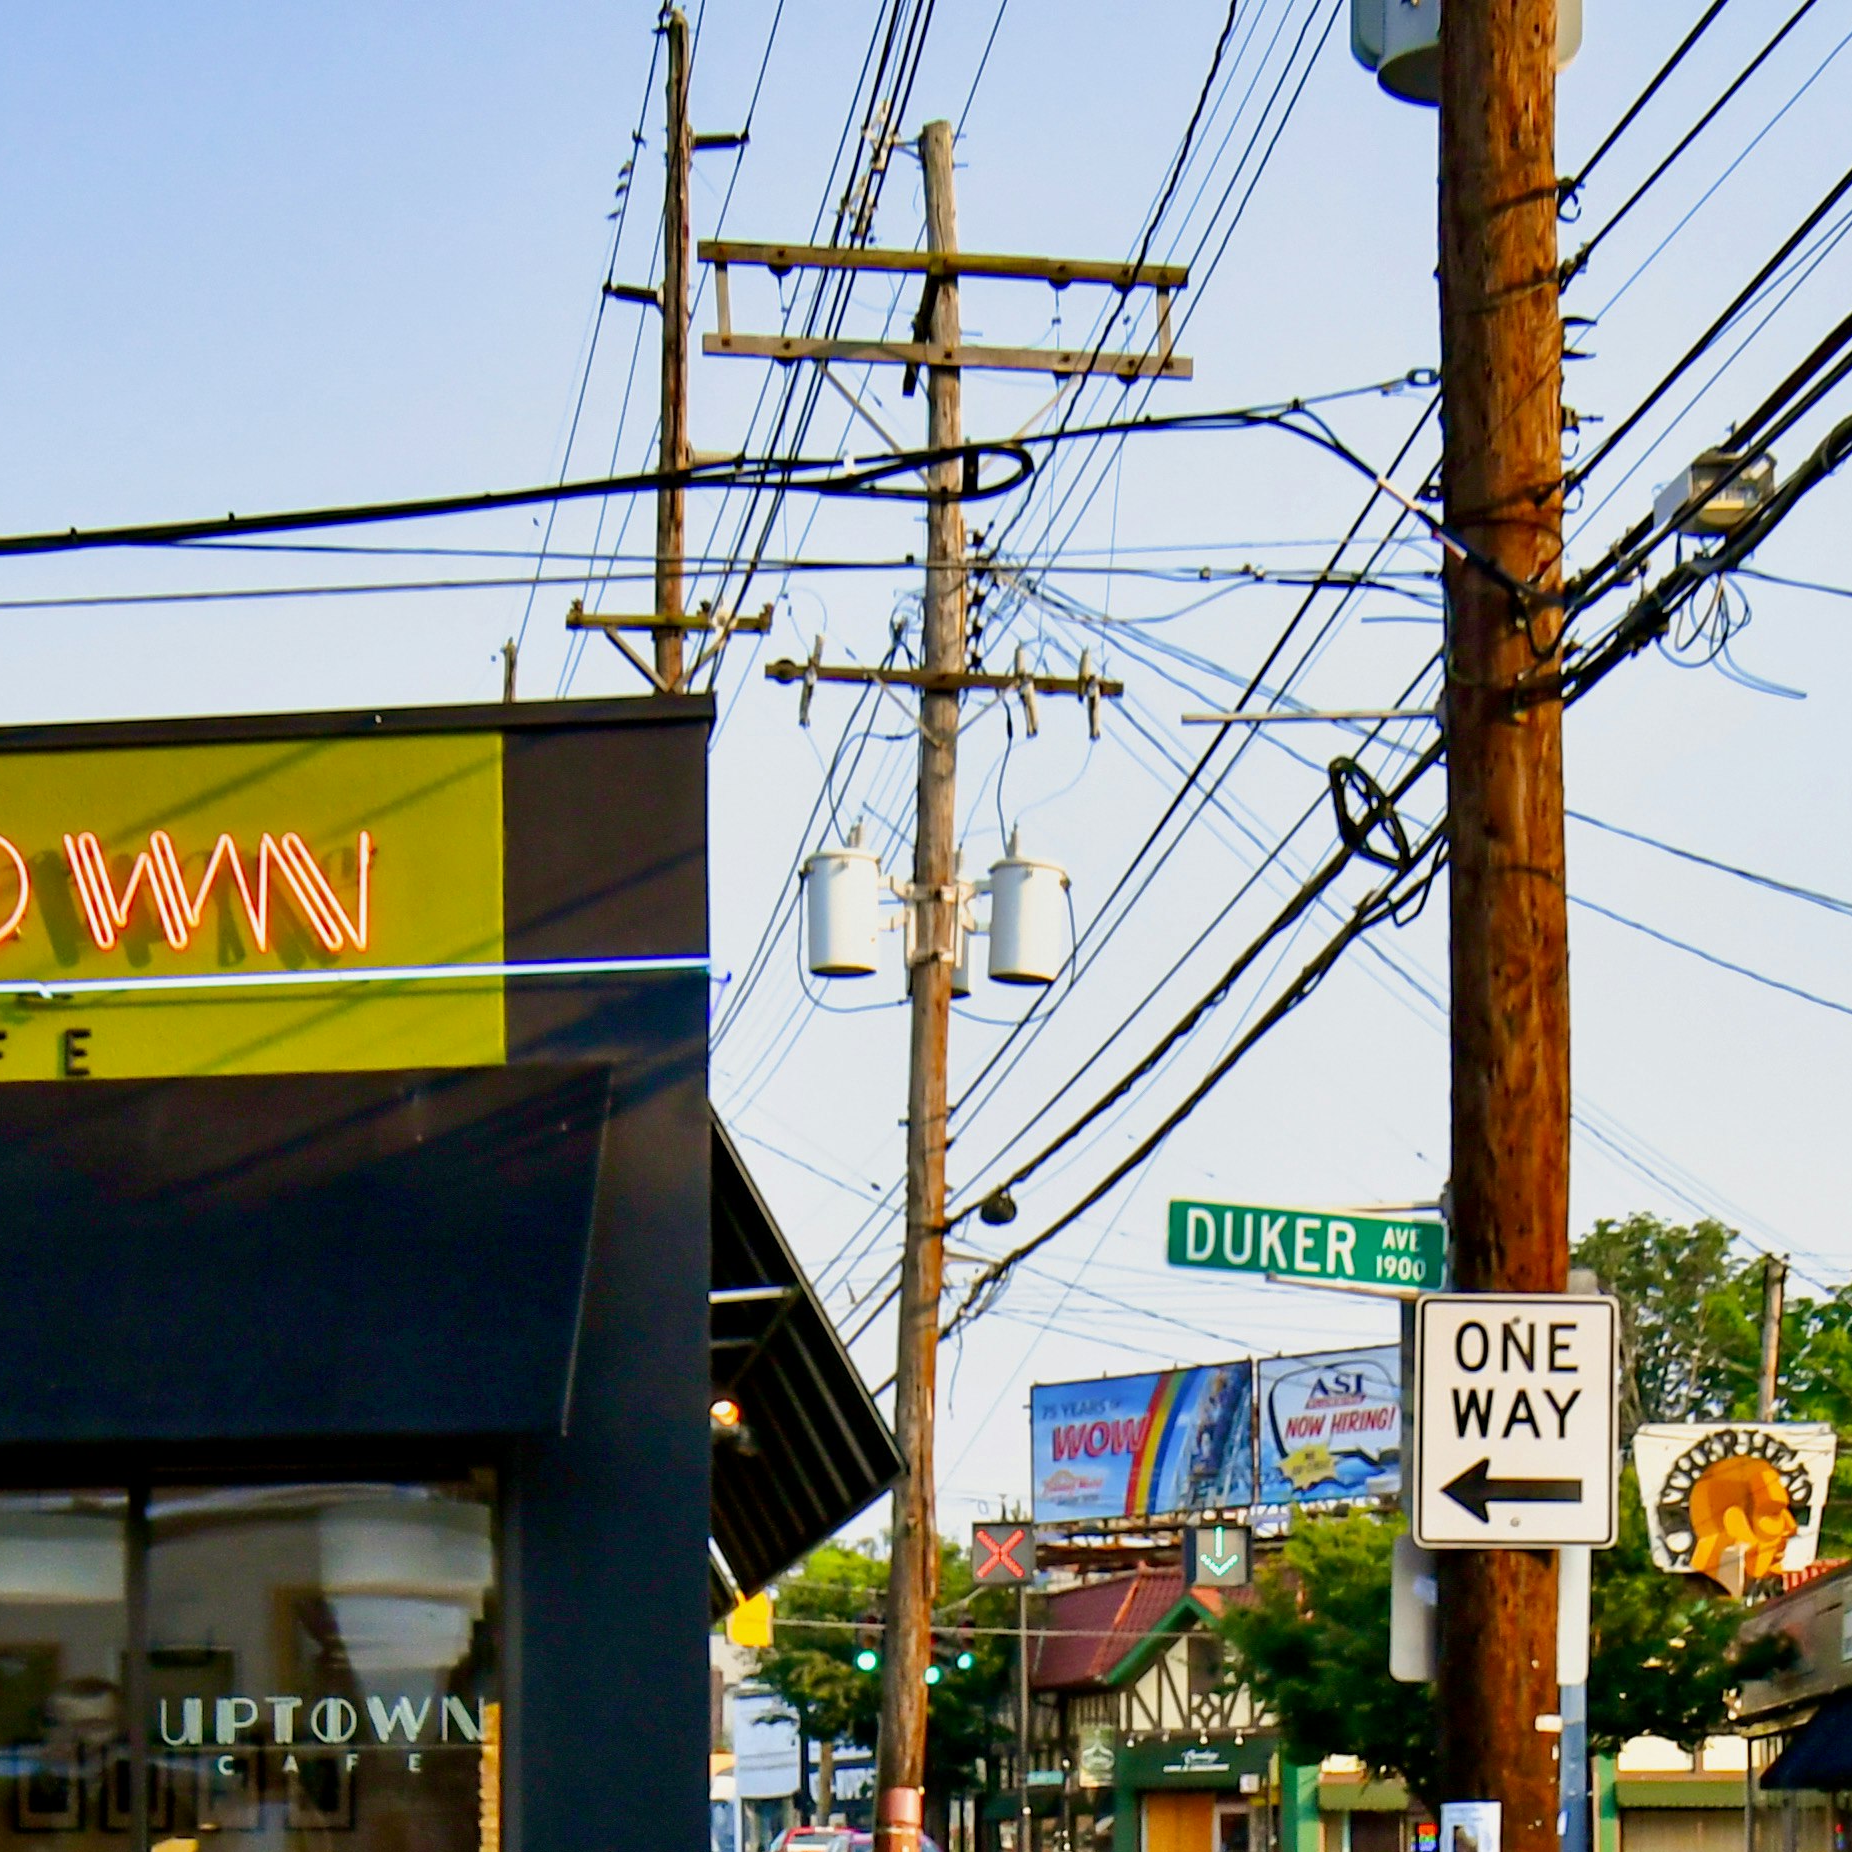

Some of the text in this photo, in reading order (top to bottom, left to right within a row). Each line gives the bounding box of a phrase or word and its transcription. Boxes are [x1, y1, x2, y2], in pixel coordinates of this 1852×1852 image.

[1185, 1206, 1422, 1277] DUKER AVE
[1376, 1254, 1426, 1282] 1900
[1455, 1321, 1580, 1374] ONE
[1309, 1372, 1364, 1398] ASI
[1285, 1406, 1397, 1440] NOW HIRING!
[1452, 1387, 1582, 1440] WAY
[1052, 1416, 1148, 1462] WOW
[159, 1696, 487, 1746] UPTOWN
[217, 1753, 421, 1777] CAFE
